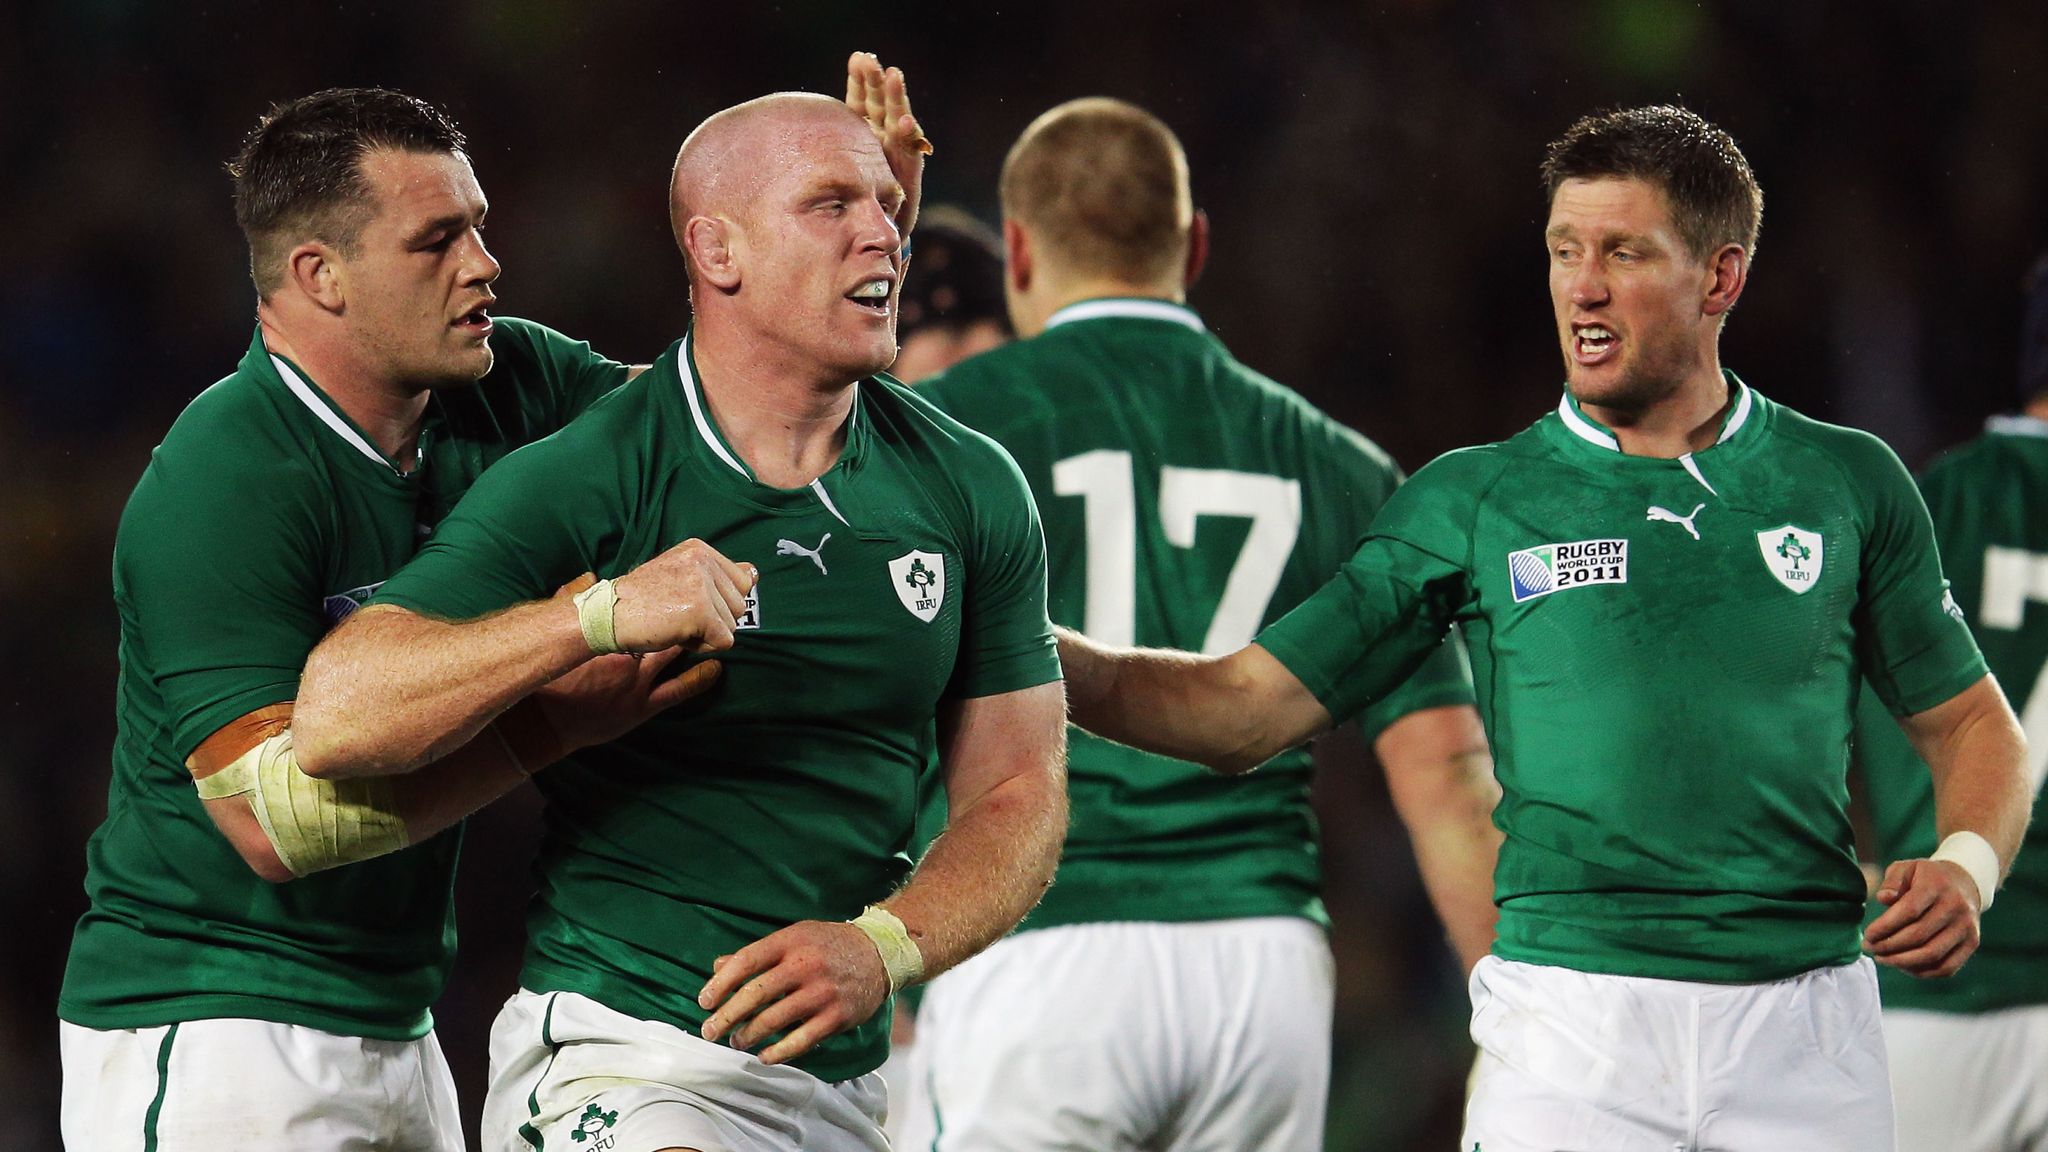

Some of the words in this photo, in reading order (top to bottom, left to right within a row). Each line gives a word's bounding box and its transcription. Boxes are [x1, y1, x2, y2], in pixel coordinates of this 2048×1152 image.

[1052, 448, 1303, 658] 17
[1557, 541, 1625, 560] RUGBY
[1557, 557, 1598, 570] WORLD
[1600, 556, 1624, 565] CUP
[1557, 566, 1622, 587] 2011
[1785, 570, 1810, 581] IRFU
[915, 598, 937, 611] IRFU
